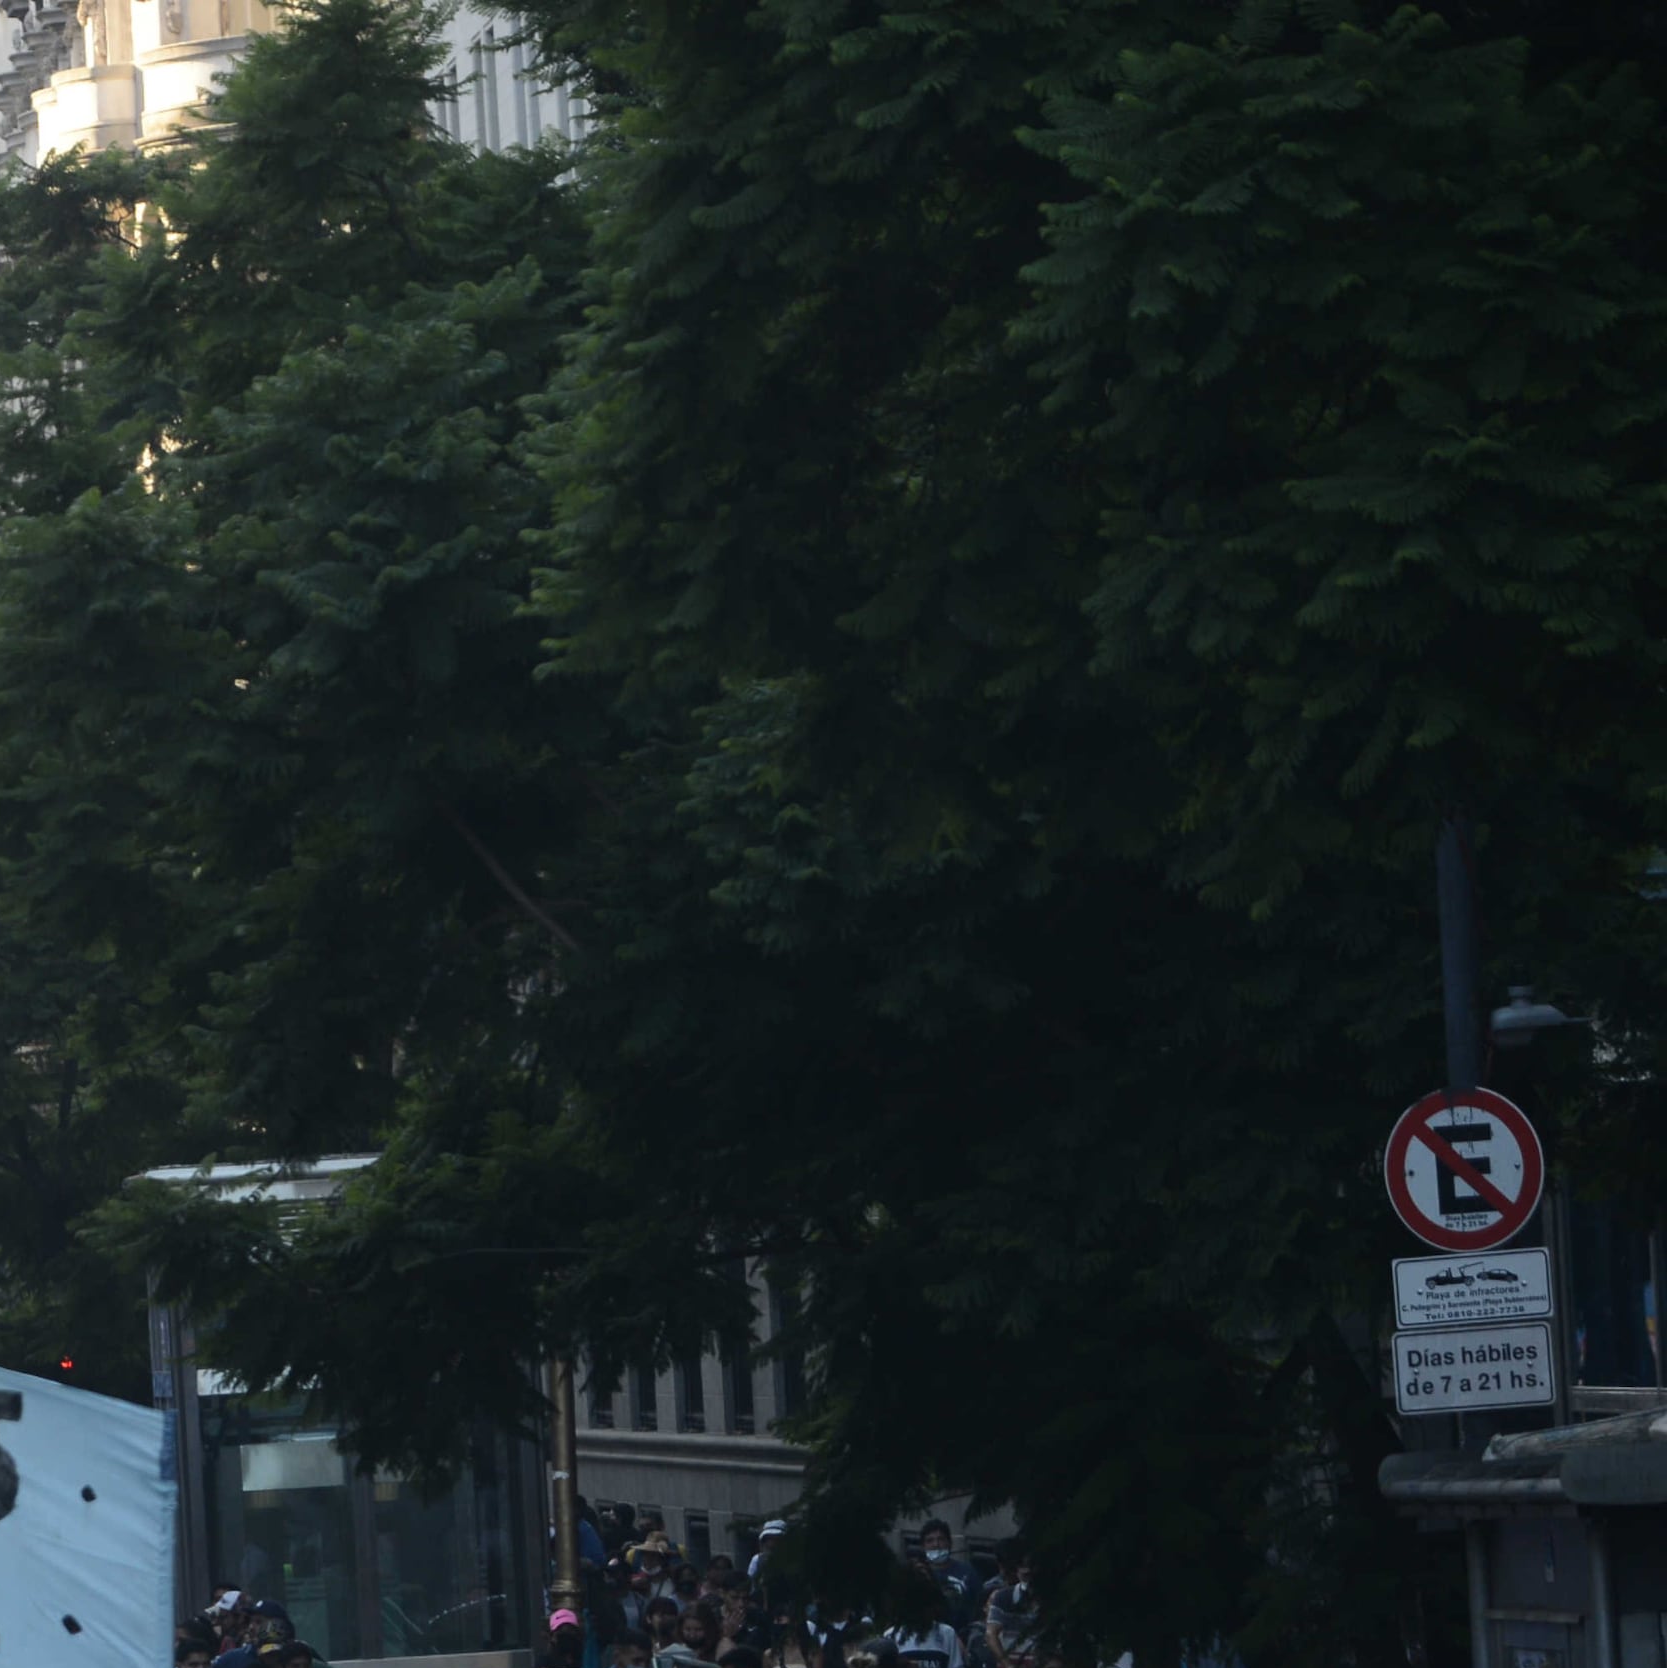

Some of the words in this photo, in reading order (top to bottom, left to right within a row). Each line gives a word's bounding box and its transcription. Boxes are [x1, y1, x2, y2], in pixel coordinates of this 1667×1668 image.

[1425, 1290, 1450, 1300] Playa
[1454, 1288, 1465, 1297] de
[1469, 1285, 1520, 1296] infractores
[1407, 1348, 1455, 1368] Días
[1461, 1343, 1539, 1364] hábiles
[1406, 1377, 1434, 1395] de
[1440, 1376, 1452, 1394] 7
[1459, 1377, 1472, 1392] a
[1478, 1372, 1501, 1391] 21
[1510, 1370, 1545, 1389] hs.
